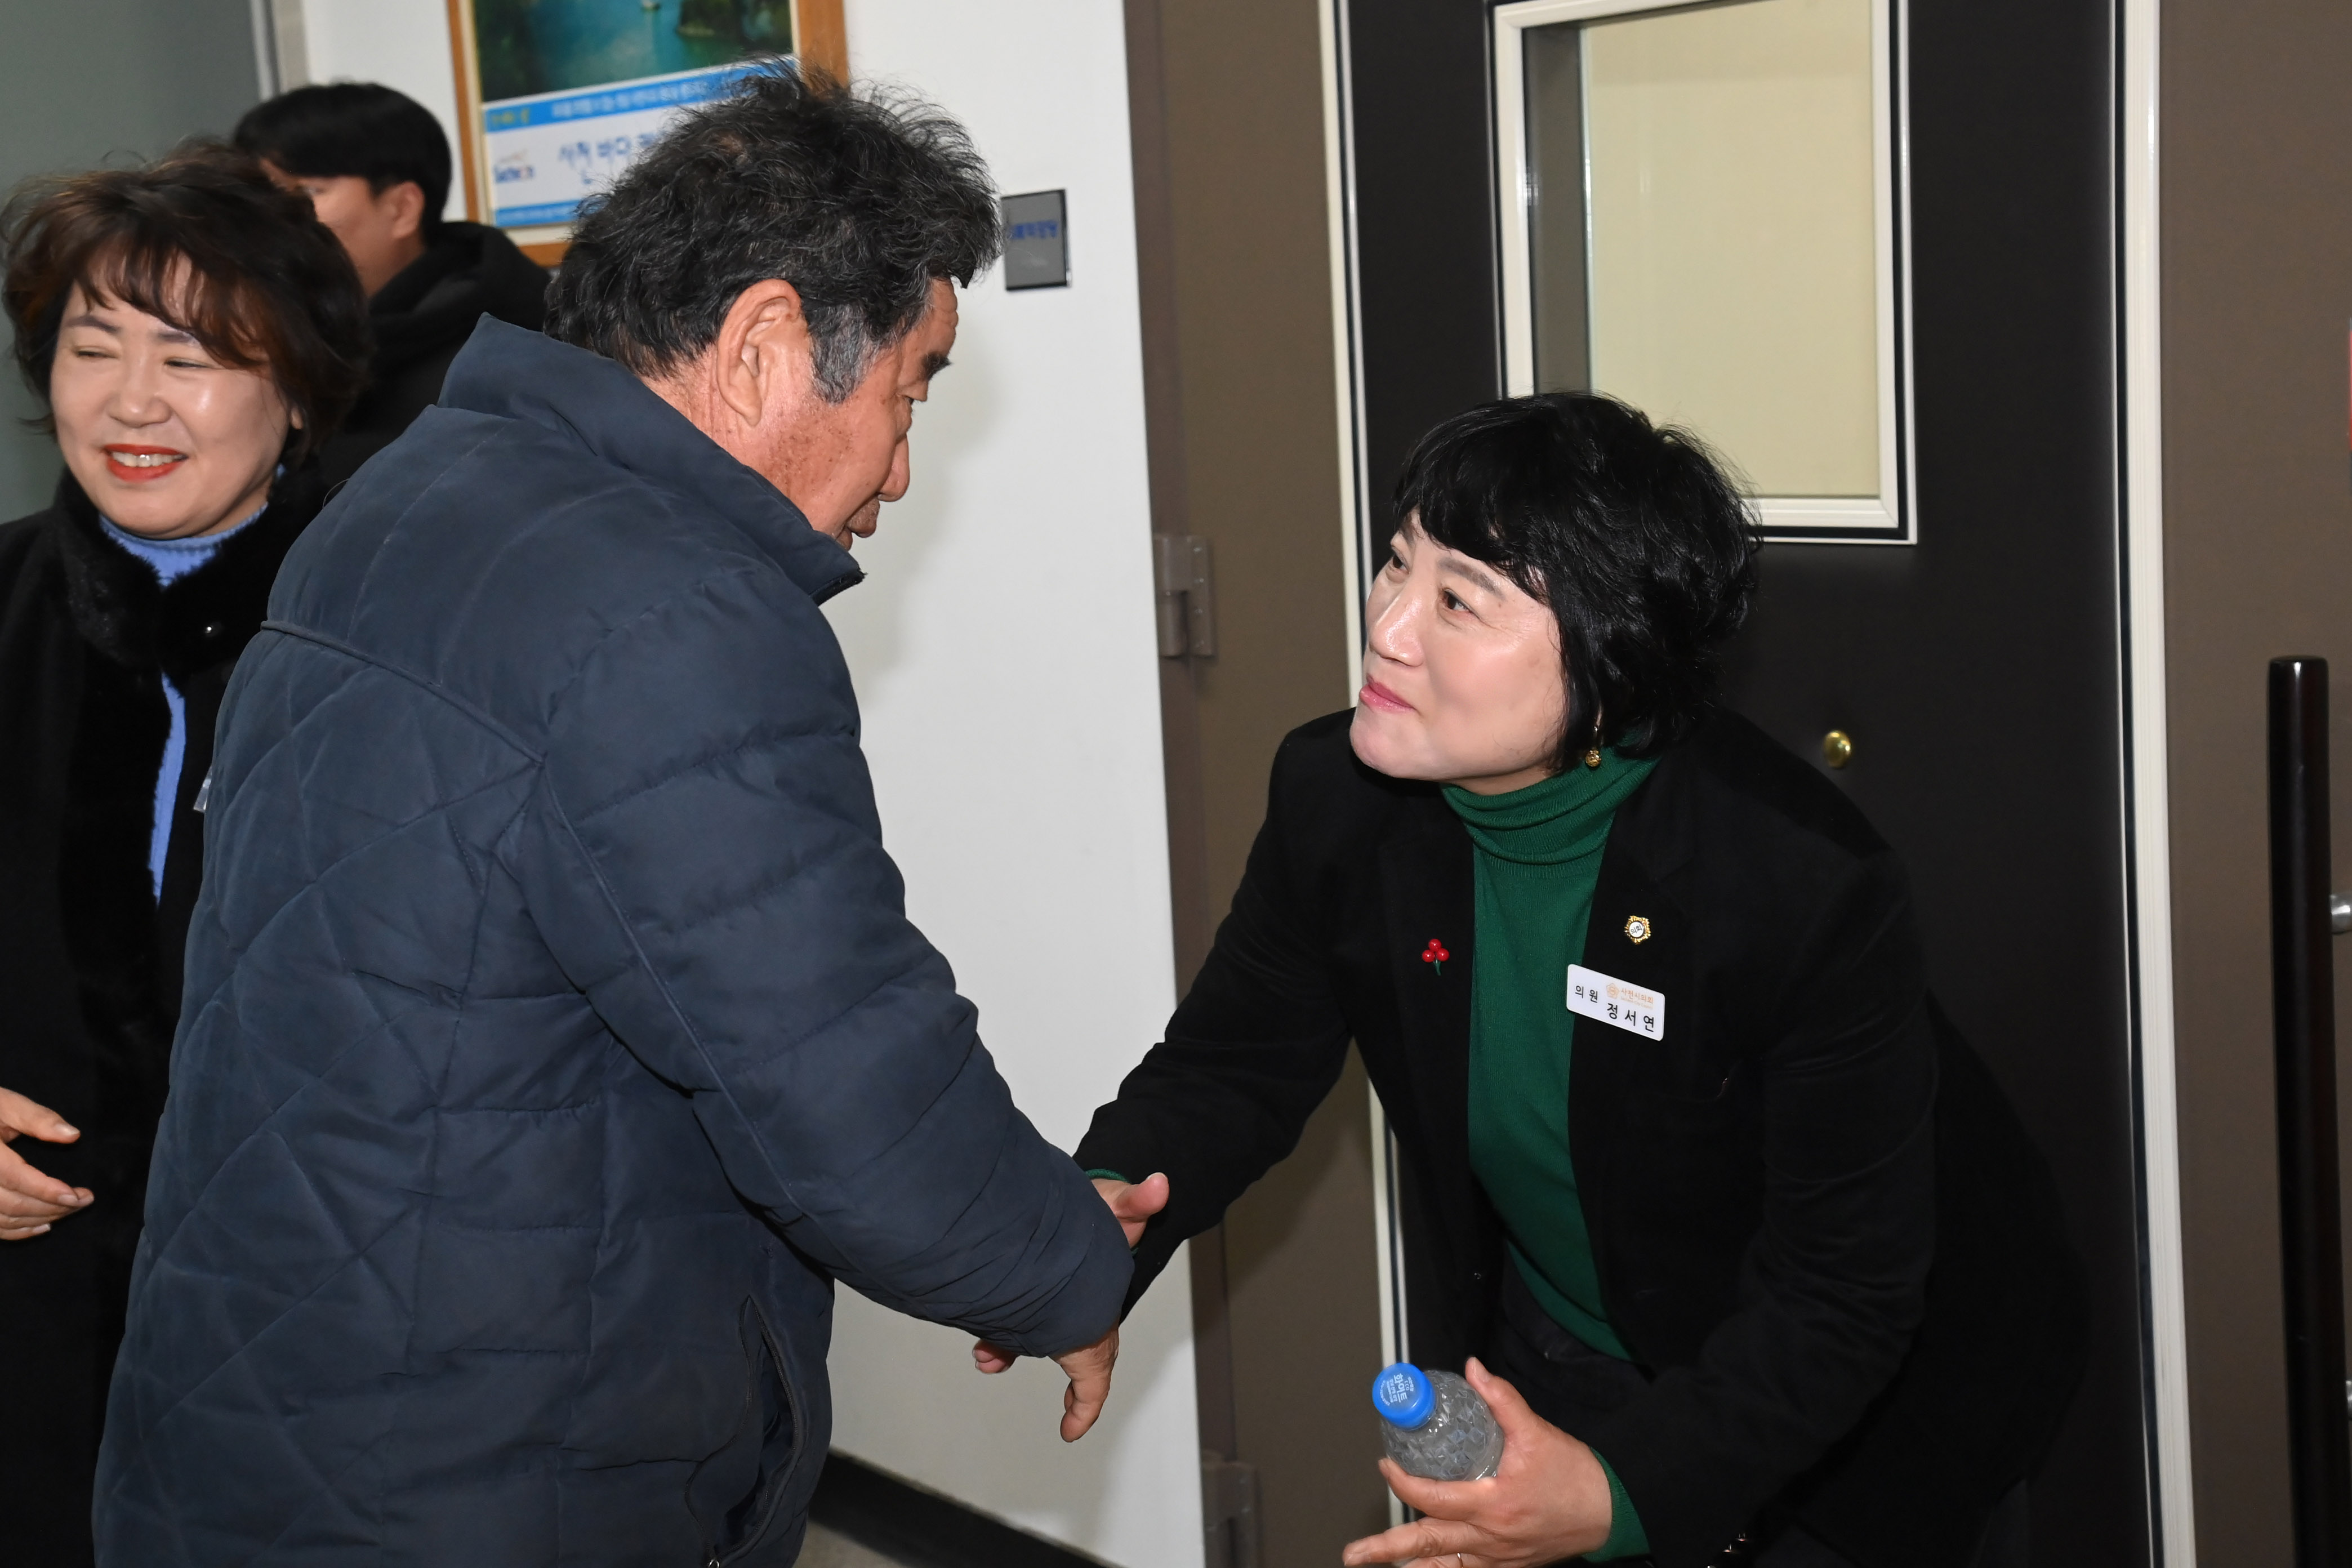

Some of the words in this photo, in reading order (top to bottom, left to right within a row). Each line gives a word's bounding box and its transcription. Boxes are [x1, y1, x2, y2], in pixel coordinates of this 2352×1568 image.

[1631, 924, 1643, 934] 의회
[1621, 988, 1654, 1004] 사천시의회
[1575, 985, 1598, 1003] 의원
[1607, 1003, 1654, 1032] 정서연
[1394, 1373, 1407, 1403] 화이트
